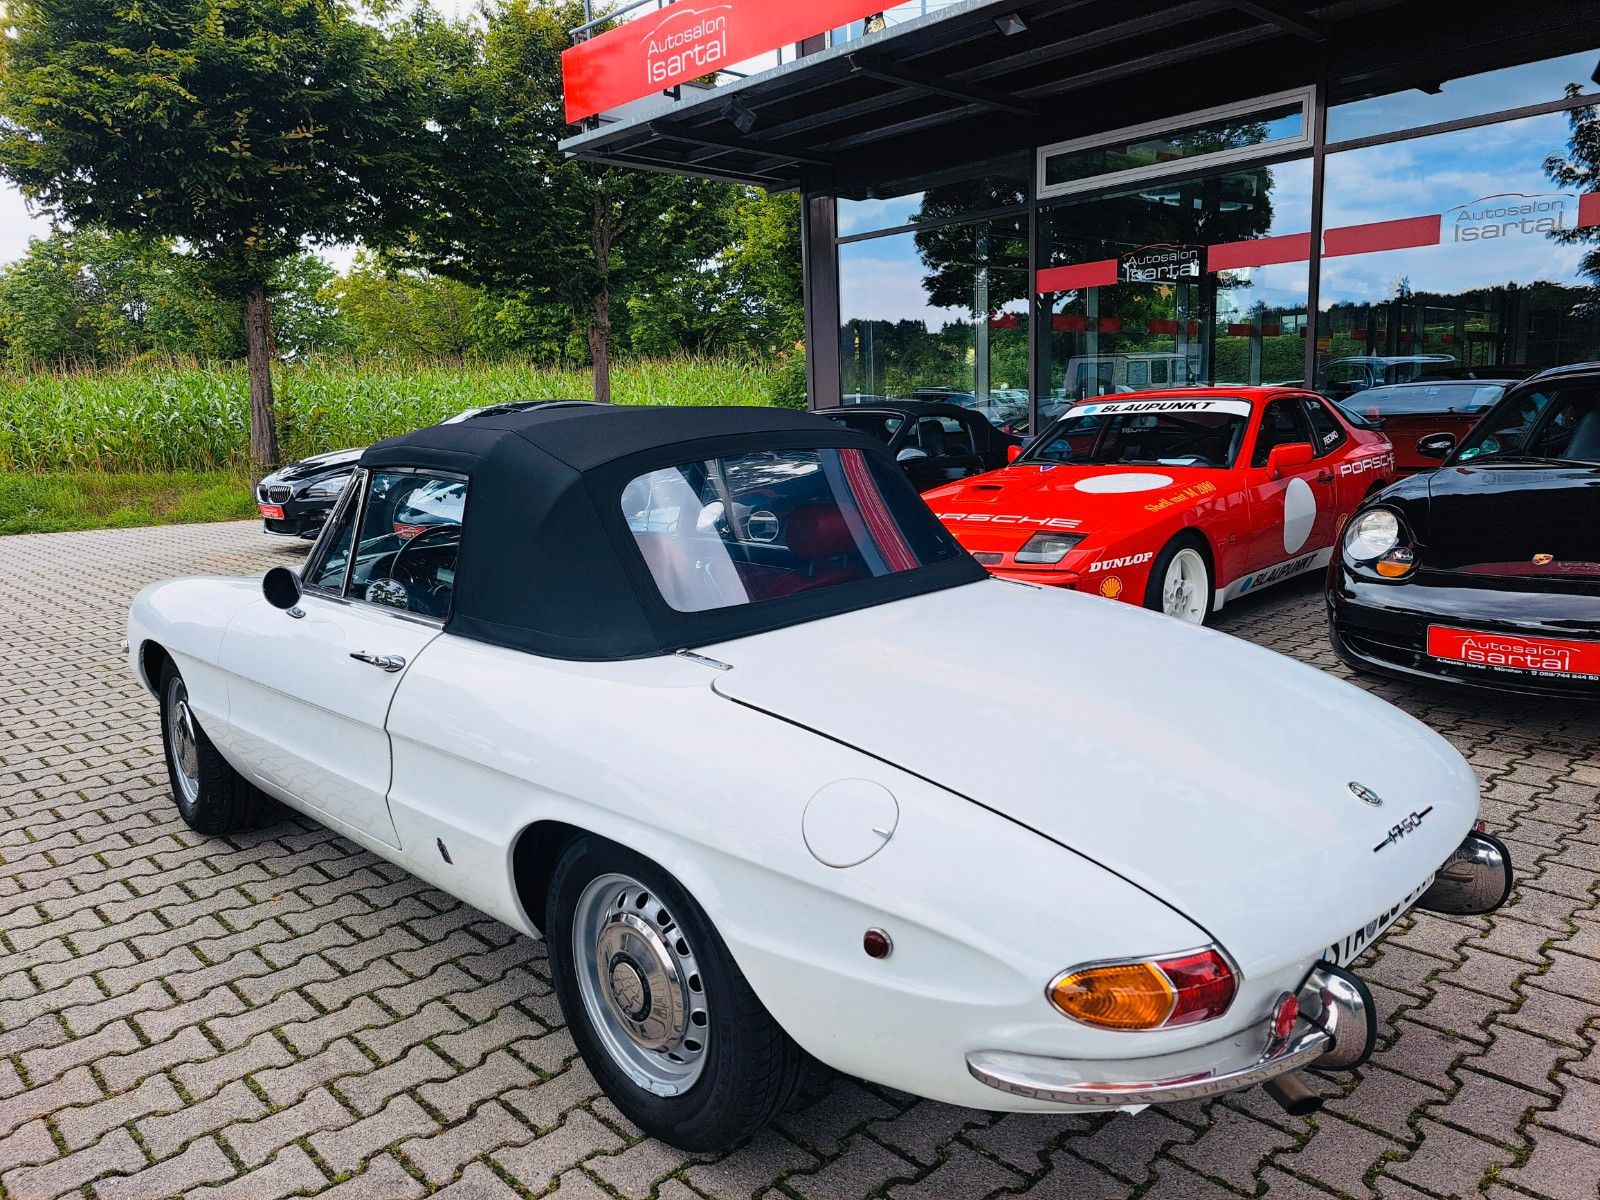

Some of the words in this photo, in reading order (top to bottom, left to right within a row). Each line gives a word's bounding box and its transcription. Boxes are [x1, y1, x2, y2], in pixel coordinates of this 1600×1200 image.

[647, 16, 726, 58] Autosalon
[647, 29, 727, 85] Isartal
[1456, 200, 1565, 223] Autosalon
[1454, 210, 1564, 242] Isartal
[1128, 250, 1198, 266] Autosalon
[1126, 259, 1199, 283] Isartal
[1100, 401, 1216, 413] BLAUPUNKT
[1340, 452, 1395, 478] PORSCHE
[1183, 487, 1199, 499] M
[1194, 480, 1217, 495] 2000
[935, 513, 1083, 529] RSCHE
[1088, 551, 1154, 573] DUNLOP
[1250, 552, 1319, 590] BLAUPUNKT
[1461, 644, 1570, 671] Isartal
[1463, 637, 1570, 657] Autosalon
[1494, 666, 1523, 674] München
